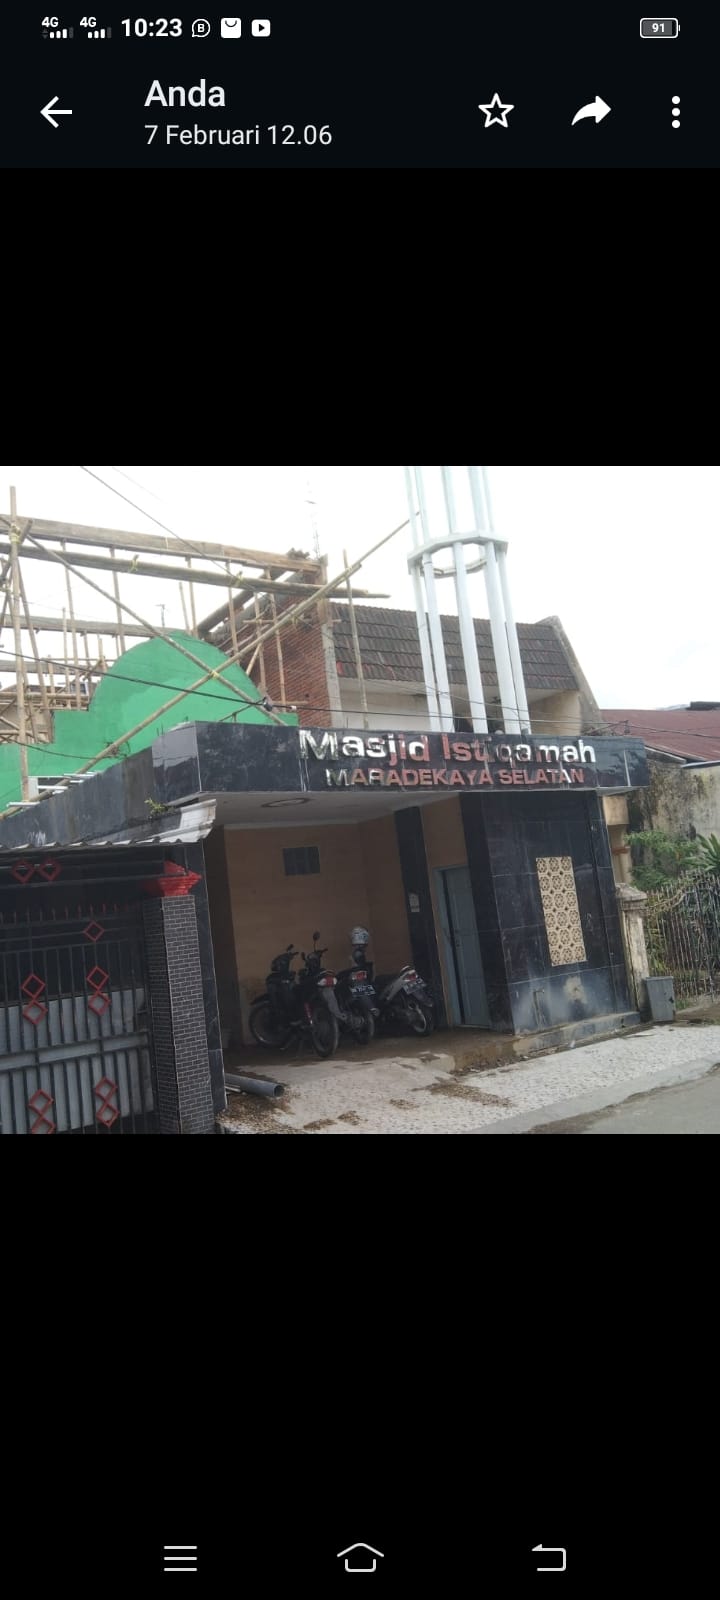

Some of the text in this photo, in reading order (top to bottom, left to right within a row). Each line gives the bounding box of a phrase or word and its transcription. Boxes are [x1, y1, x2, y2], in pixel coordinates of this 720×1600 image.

[299, 729, 429, 765] Masjid
[325, 767, 585, 787] MARADEKAYA SELATAN
